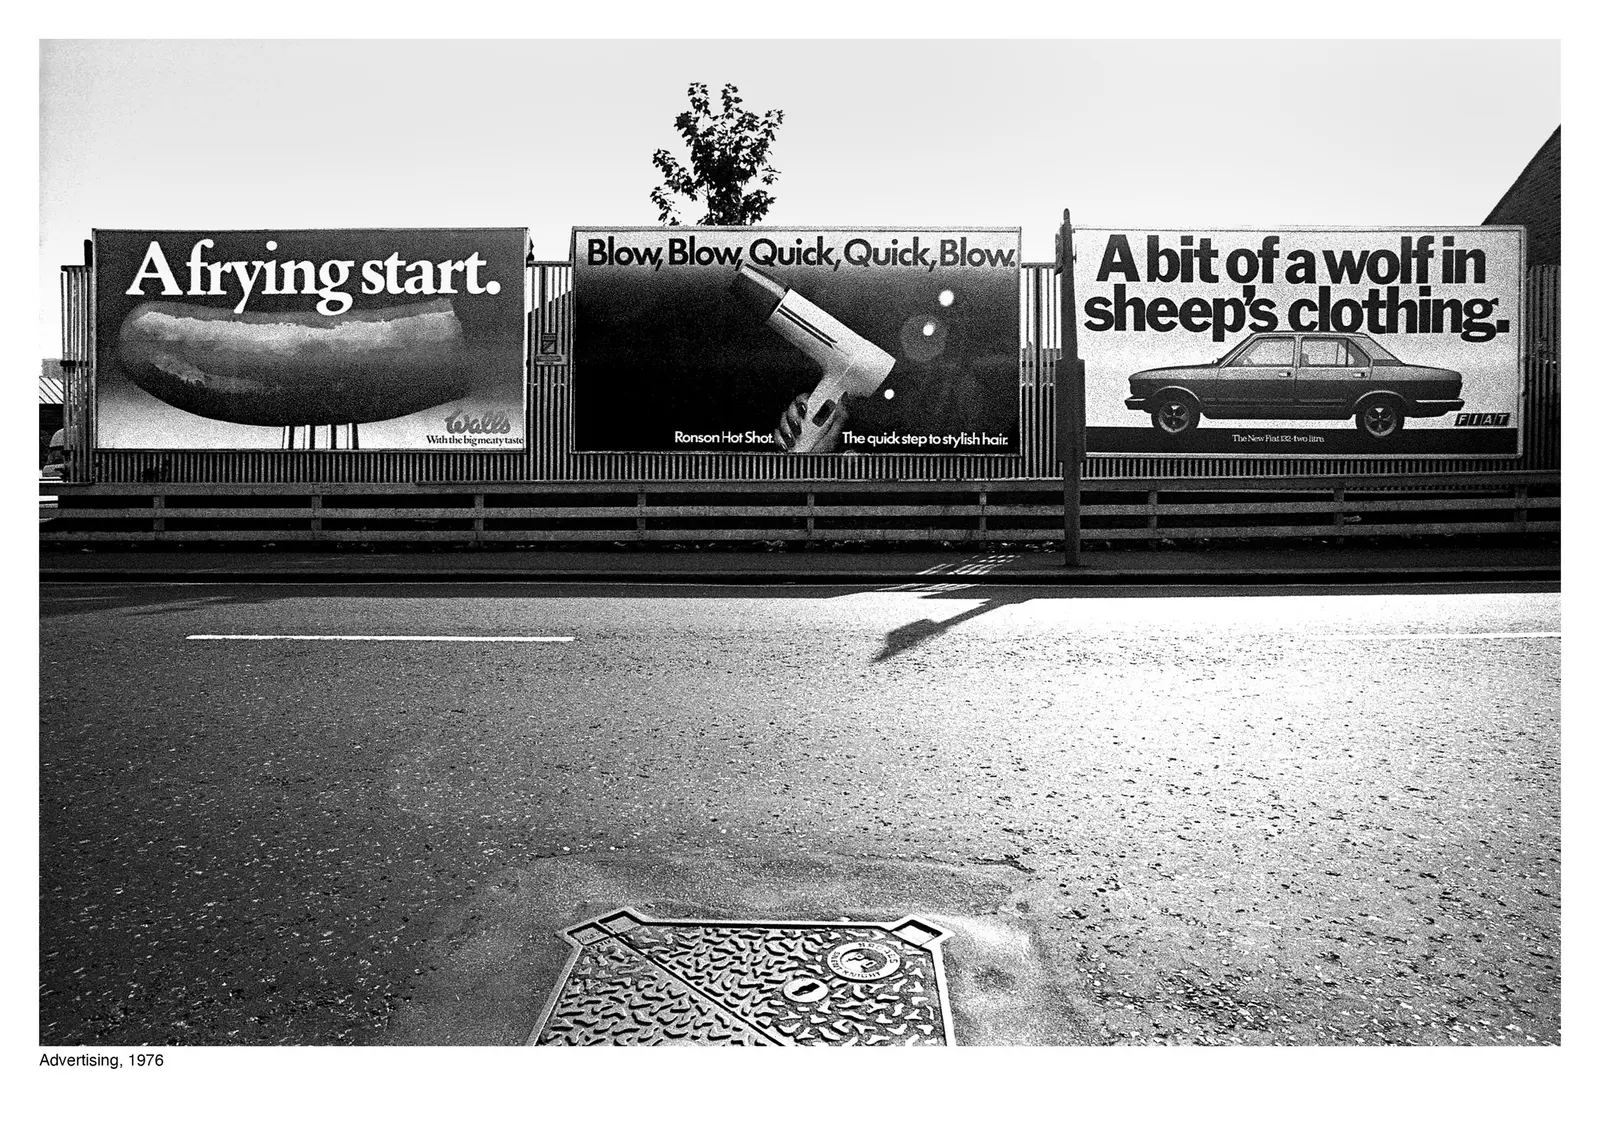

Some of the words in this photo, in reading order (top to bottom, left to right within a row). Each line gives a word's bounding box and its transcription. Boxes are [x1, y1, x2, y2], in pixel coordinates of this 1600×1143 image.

[588, 236, 663, 271] Blow,
[668, 236, 743, 271] Blow,
[749, 236, 841, 272] Quick,
[844, 236, 937, 272] Quick,
[940, 236, 1016, 267] Blow.
[1096, 234, 1140, 283] A
[1147, 235, 1219, 283] bit
[1226, 236, 1279, 284] of
[1285, 248, 1316, 284] a
[1323, 236, 1434, 285] wolf
[1442, 236, 1486, 284] in
[125, 241, 183, 296] A
[186, 238, 355, 316] frying
[361, 251, 501, 295] start.
[1084, 283, 1279, 342] sheep's
[1287, 286, 1510, 343] clothing.
[1458, 414, 1507, 425] FIAT
[426, 434, 448, 444] With
[449, 434, 463, 444] the
[464, 434, 478, 447] big
[478, 437, 504, 447] meaty
[675, 431, 720, 444] Ronson
[722, 431, 743, 444] Hot
[745, 431, 775, 444] Shot.
[842, 431, 865, 444] The
[867, 431, 900, 447] quick
[902, 434, 927, 447] step
[929, 434, 941, 444] to
[943, 432, 980, 448] stylish
[983, 432, 1009, 445] hair.
[1232, 434, 1247, 442] The
[1248, 434, 1265, 442] New
[1265, 434, 1280, 442] Fiat
